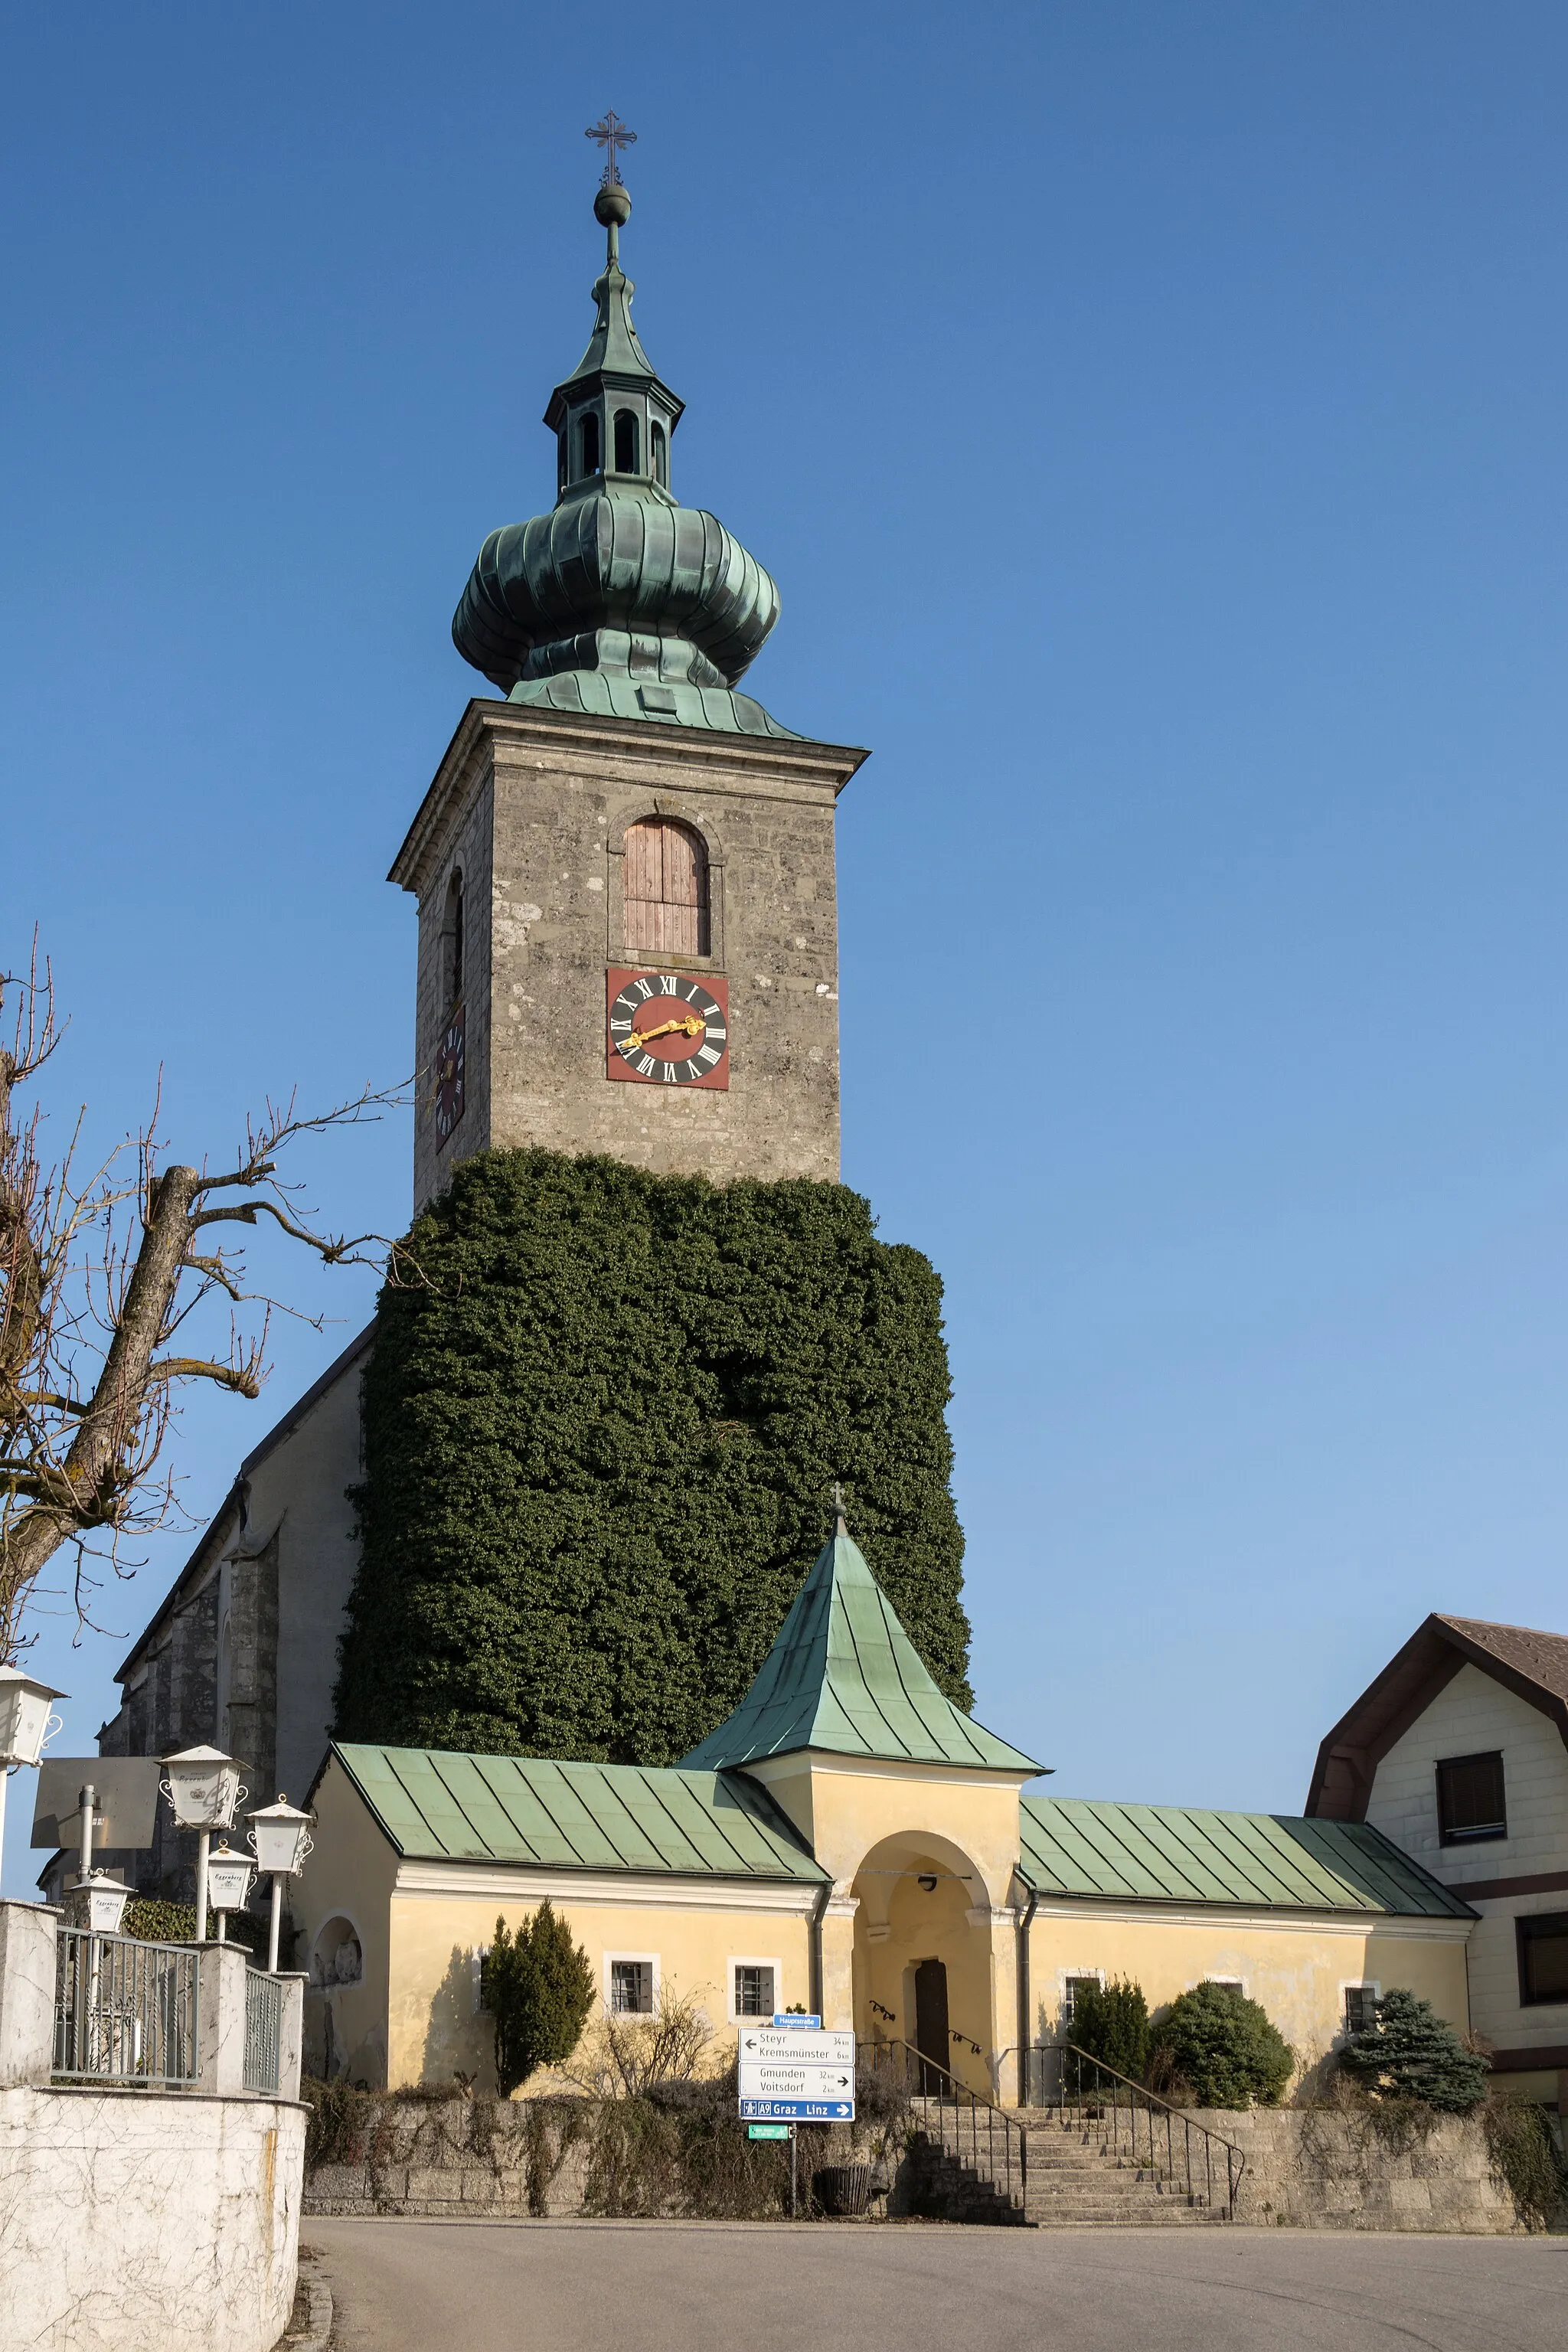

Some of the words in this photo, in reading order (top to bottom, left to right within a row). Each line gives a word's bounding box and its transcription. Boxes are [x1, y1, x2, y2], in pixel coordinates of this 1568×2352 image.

[634, 978, 654, 1000] XI
[659, 975, 678, 995] XII
[685, 985, 699, 1002] I
[616, 994, 639, 1011] X
[703, 1004, 720, 1017] II
[610, 1018, 632, 1031] IX
[706, 1027, 727, 1040] III
[616, 1040, 640, 1060] VII
[697, 1044, 722, 1066] IIII
[635, 1054, 656, 1077] VII
[663, 1062, 678, 1083] VI
[686, 1059, 703, 1080] V
[779, 2017, 815, 2025] Hauptstraße
[760, 2033, 787, 2045] Steyr
[760, 2047, 829, 2059] Kremsmünster
[837, 2051, 841, 2060] 6
[760, 2067, 805, 2079] Gmunden
[819, 2070, 827, 2079] 32
[760, 2082, 805, 2092] Voitsdorf
[822, 2085, 827, 2093] 2
[760, 2104, 770, 2114] A9
[773, 2104, 797, 2115] Graz
[806, 2104, 828, 2115] Linz
